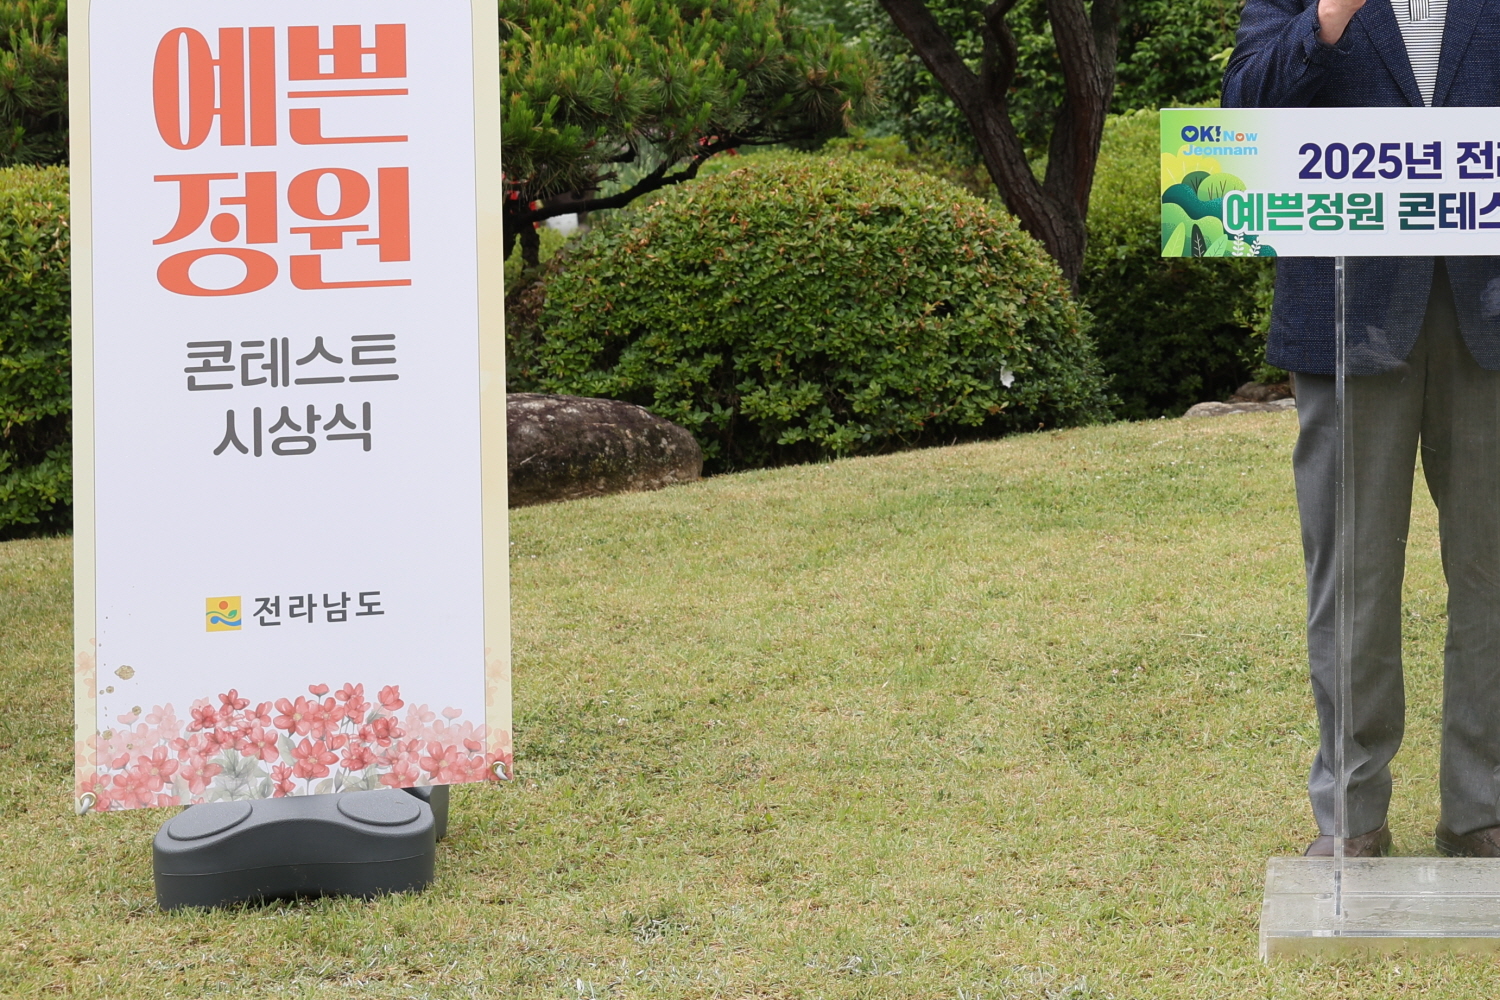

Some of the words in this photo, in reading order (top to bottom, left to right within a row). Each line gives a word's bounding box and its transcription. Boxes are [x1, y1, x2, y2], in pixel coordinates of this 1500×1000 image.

[152, 23, 409, 151] 예쁜
[1181, 125, 1222, 142] OK!
[1223, 130, 1258, 142] Now
[1182, 144, 1258, 156] Jeonnam
[1298, 141, 1443, 179] 2025년
[1226, 192, 1385, 231] 예쁜정원
[152, 166, 412, 297] 정원
[184, 333, 400, 391] 콘테스트
[213, 401, 372, 458] 시상식
[252, 590, 385, 627] 전라남도
